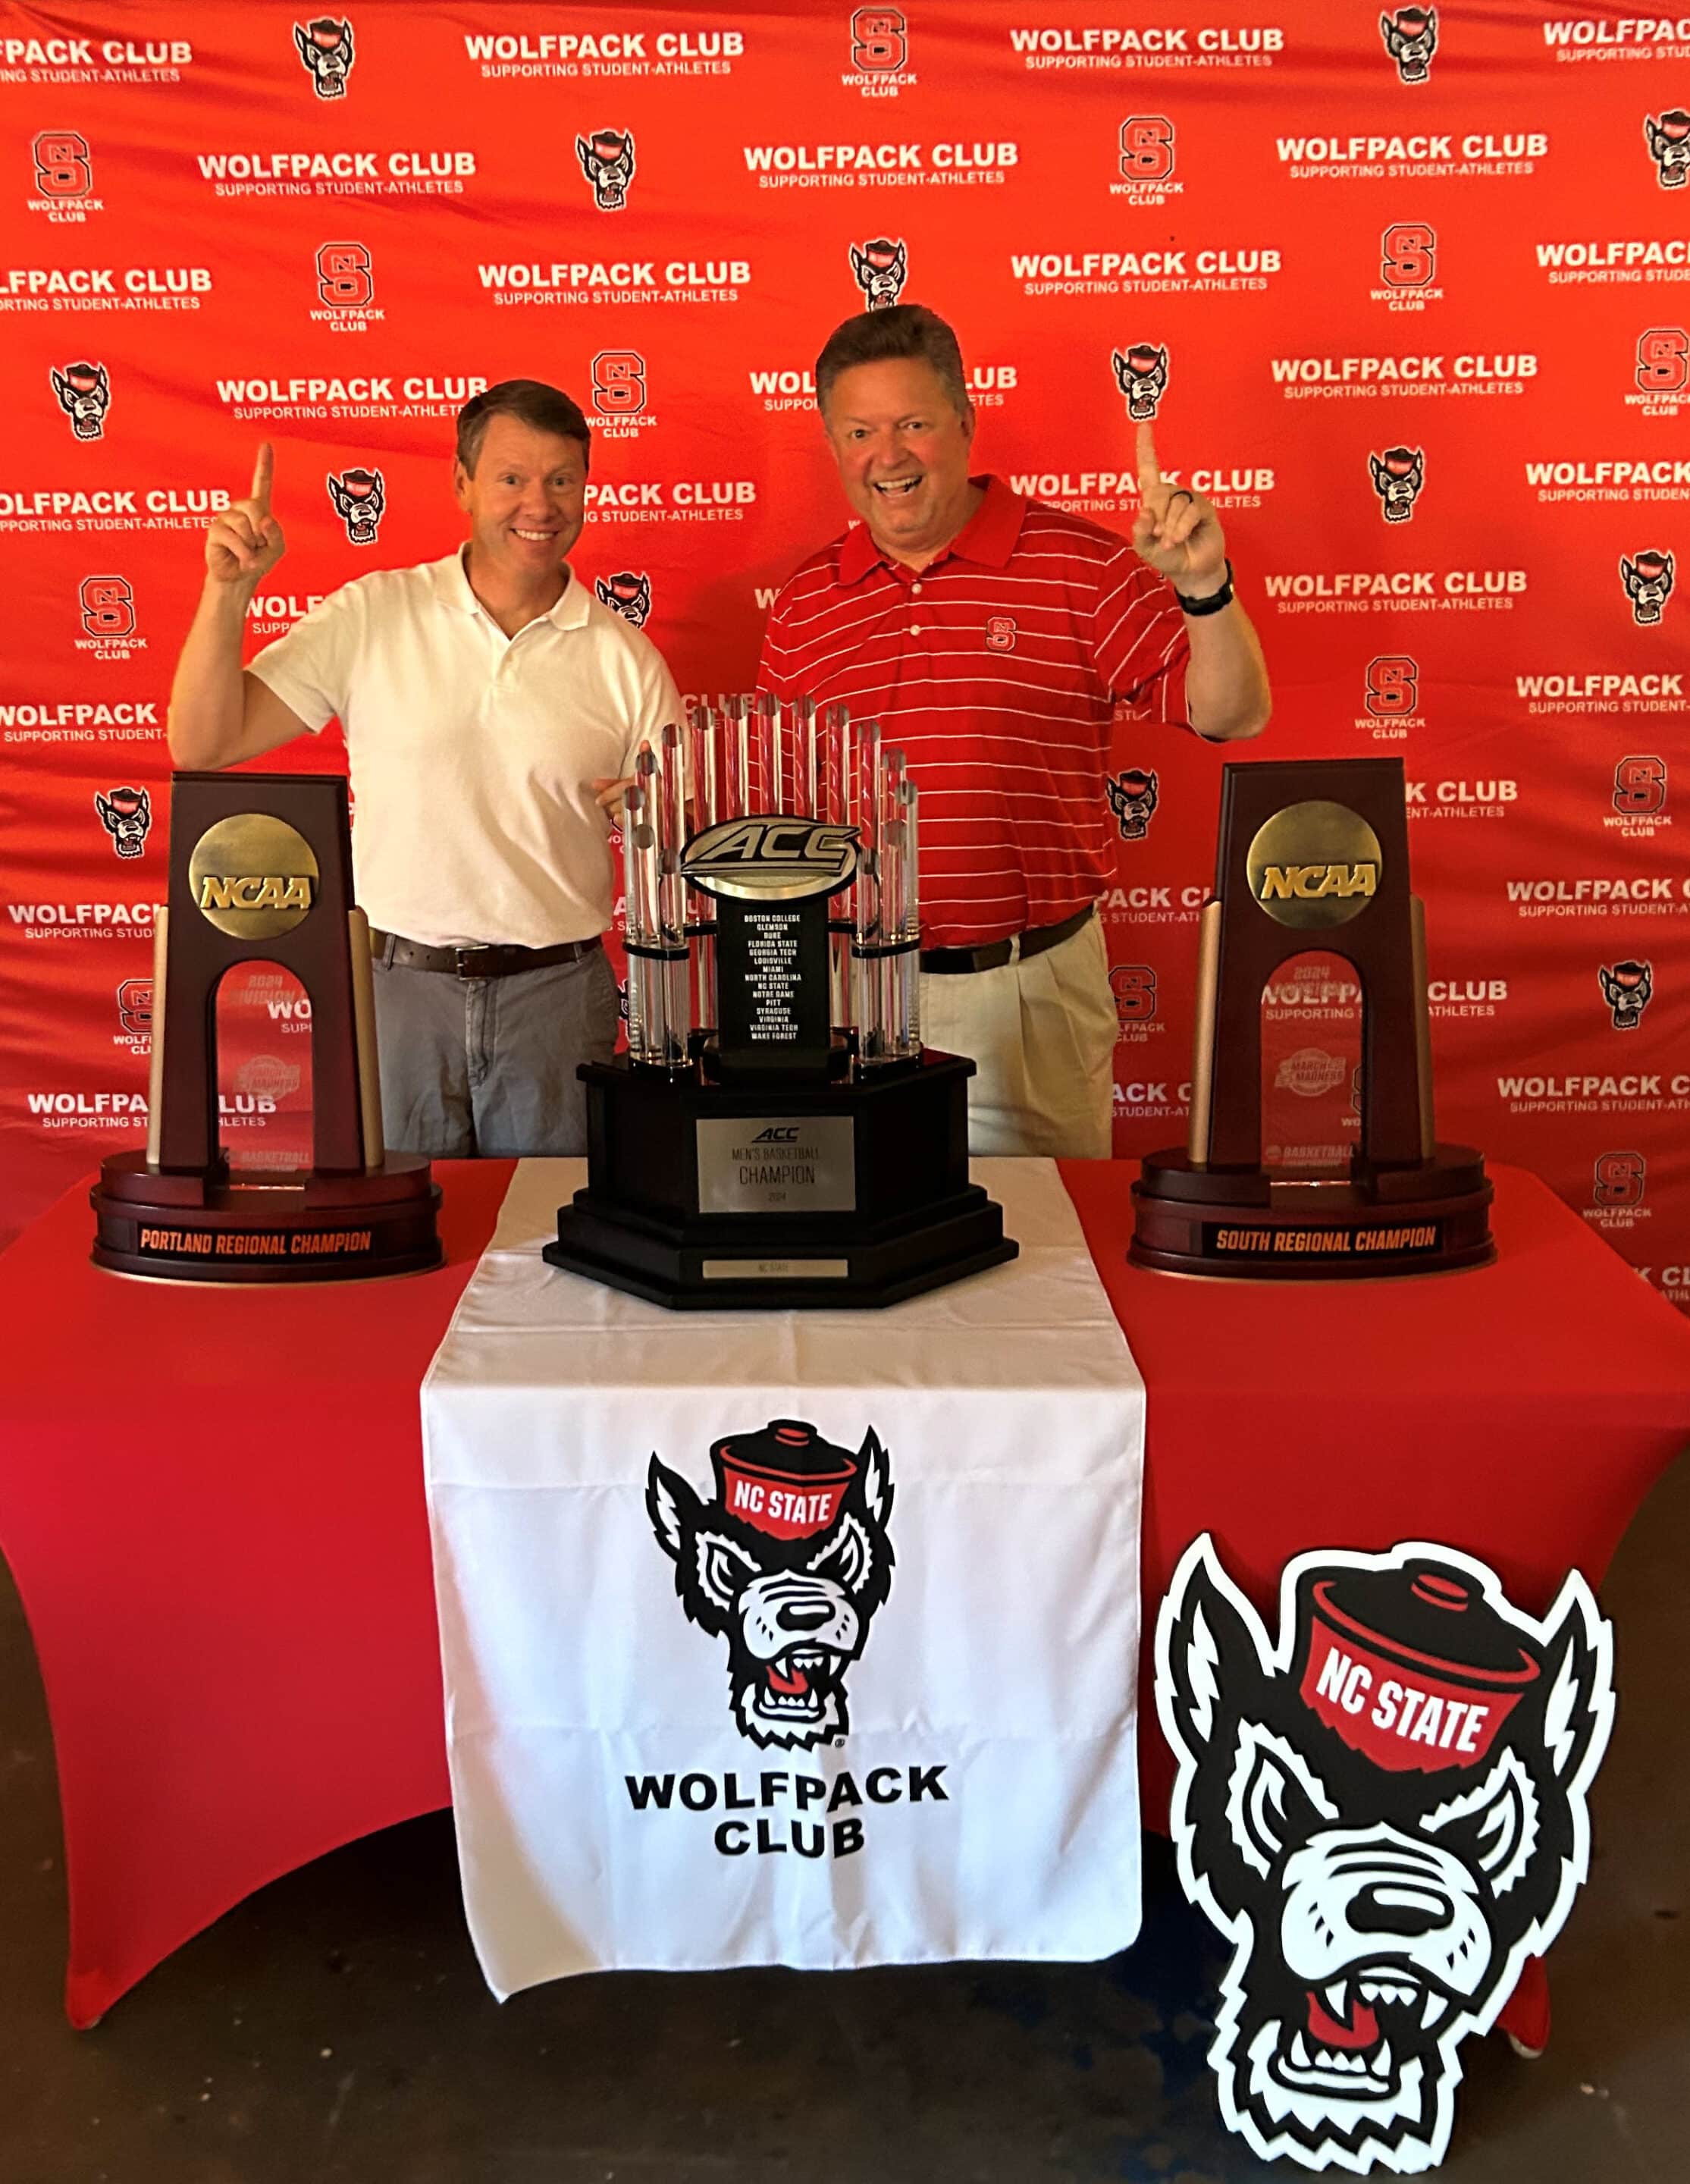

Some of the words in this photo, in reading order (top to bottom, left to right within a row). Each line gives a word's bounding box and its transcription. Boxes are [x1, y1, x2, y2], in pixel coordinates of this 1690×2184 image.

[1544, 19, 1690, 45] WOLFPAC
[465, 34, 645, 59] WOLFPACK
[657, 33, 743, 57] CLUB
[1011, 30, 1187, 51] WOLFPACK
[1199, 29, 1283, 50] CLUB
[6, 40, 92, 64] PACK
[103, 42, 191, 64] CLUB
[1557, 48, 1652, 61] SUPPORTING
[481, 64, 578, 77] SUPPORTING
[582, 61, 730, 76] STUDENT-ATHLETES
[1026, 56, 1121, 68] SUPPORTING
[1127, 56, 1271, 67] STUDENT-ATHLETES
[31, 69, 180, 82] STUDENT-ATHLETES
[842, 74, 916, 85] WOLFPACK
[861, 86, 898, 96] CLUB
[1277, 136, 1450, 161] WOLFPACK
[1463, 135, 1547, 158] CLUB
[745, 146, 920, 170] WOLFPACK
[933, 143, 1017, 167] CLUB
[198, 154, 378, 178] WOLFPACK
[389, 152, 475, 176] CLUB
[1290, 165, 1384, 177] SUPPORTING
[1389, 162, 1533, 177] STUDENT-ATHLETES
[760, 174, 854, 188] SUPPORTING
[859, 171, 1004, 186] STUDENT-ATHLETES
[215, 184, 311, 196] SUPPORTING
[316, 180, 463, 194] STUDENT-ATHLETES
[1110, 183, 1183, 193] WOLFPACK
[28, 199, 103, 210] WOLFPACK
[1129, 195, 1165, 205] CLUB
[49, 212, 86, 222] CLUB
[1537, 241, 1690, 266] WOLFPAC
[1011, 253, 1185, 278] WOLFPACK
[1196, 250, 1280, 273] CLUB
[0, 270, 115, 293] FPACK
[125, 269, 212, 292] CLUB
[478, 263, 655, 287] WOLFPACK
[666, 262, 750, 284] CLUB
[1549, 271, 1641, 283] SUPPORTING
[1025, 281, 1118, 295] SUPPORTING
[1124, 278, 1267, 292] STUDENT-ATHLETES
[494, 292, 588, 304] SUPPORTING
[593, 290, 738, 303] STUDENT-ATHLETES
[1371, 289, 1442, 300] WOLFPACK
[0, 299, 49, 310] RTING
[53, 297, 199, 310] STUDENT-ATHLETES
[1389, 300, 1425, 311] CLUB
[310, 309, 384, 320] WOLFPACK
[331, 322, 366, 331] CLUB
[1272, 357, 1443, 381] WOLFPACK
[1454, 356, 1537, 378] CLUB
[217, 378, 393, 402] WOLFPACK
[404, 378, 488, 400] CLUB
[1284, 385, 1377, 398] SUPPORTING
[1381, 382, 1522, 396] STUDENT-ATHLETES
[234, 406, 327, 419] SUPPORTING
[1642, 406, 1677, 416] CLUB
[604, 428, 638, 438] CLUB
[1191, 469, 1275, 491] CLUB
[584, 485, 662, 506] PACK
[673, 482, 755, 504] CLUB
[1538, 490, 1629, 501] SUPPORTING
[0, 492, 136, 515] OLFPACK
[146, 491, 230, 512] CLUB
[603, 509, 743, 522] STUDENT-ATHLETES
[0, 519, 72, 531] PPORTING
[77, 517, 216, 530] STUDENT-ATHLETE
[1265, 573, 1434, 596] WOLFPACK
[1445, 572, 1526, 593] CLUB
[1278, 601, 1369, 613] SUPPORTING
[1373, 598, 1513, 611] STUDENT-ATHLETES
[75, 639, 147, 648] WOLFPACK
[95, 650, 130, 659] CLUB
[1516, 675, 1682, 697] WOLFPACK
[1529, 702, 1618, 713] SUPPORTING
[1623, 700, 1690, 711] STUDENT-
[1355, 718, 1425, 728] WOLFPACK
[5, 730, 94, 742] SUPPORTING
[99, 728, 168, 740] STUDENT-
[1373, 730, 1407, 739] CLUB
[1437, 781, 1517, 802] CLUB
[1604, 817, 1671, 827] WOLFPACK
[1622, 827, 1654, 836] CLUB
[1261, 864, 1376, 899] NCAA
[200, 877, 311, 909] NCAA
[1507, 879, 1672, 900] WOLFPACK
[8, 902, 161, 924] WOLFPAC
[1519, 906, 1607, 917] SUPPORTING
[1612, 903, 1690, 915] STUDENT-A
[25, 928, 112, 938] SUPPORTING
[1428, 981, 1507, 1001] CLUB
[1266, 1009, 1354, 1020] SUPPORTING
[1498, 1076, 1660, 1097] WOLFPACK
[28, 1094, 147, 1112] WOLFPA
[1510, 1102, 1598, 1112] SUPPORTING
[43, 1118, 130, 1128] SUPPORTING
[753, 1127, 800, 1143] ACC
[739, 1165, 815, 1185] CHAMPION
[1583, 1208, 1651, 1217] WOLFPACK
[1601, 1219, 1634, 1227] CLUB
[141, 1228, 212, 1254] PORTLAND
[216, 1235, 287, 1255] REGIONAL
[291, 1231, 372, 1254] CHAMPION
[1216, 1229, 1271, 1250] SOUTH
[1274, 1232, 1351, 1252] REGIONAL
[1355, 1225, 1436, 1250] CHAMPION
[734, 1480, 765, 1513] NC
[768, 1490, 832, 1524] STATE
[1316, 1646, 1373, 1715] NC
[1371, 1680, 1489, 1753] STATE
[625, 1765, 950, 1812] WOLFPACK
[715, 1818, 865, 1859] CLUB
